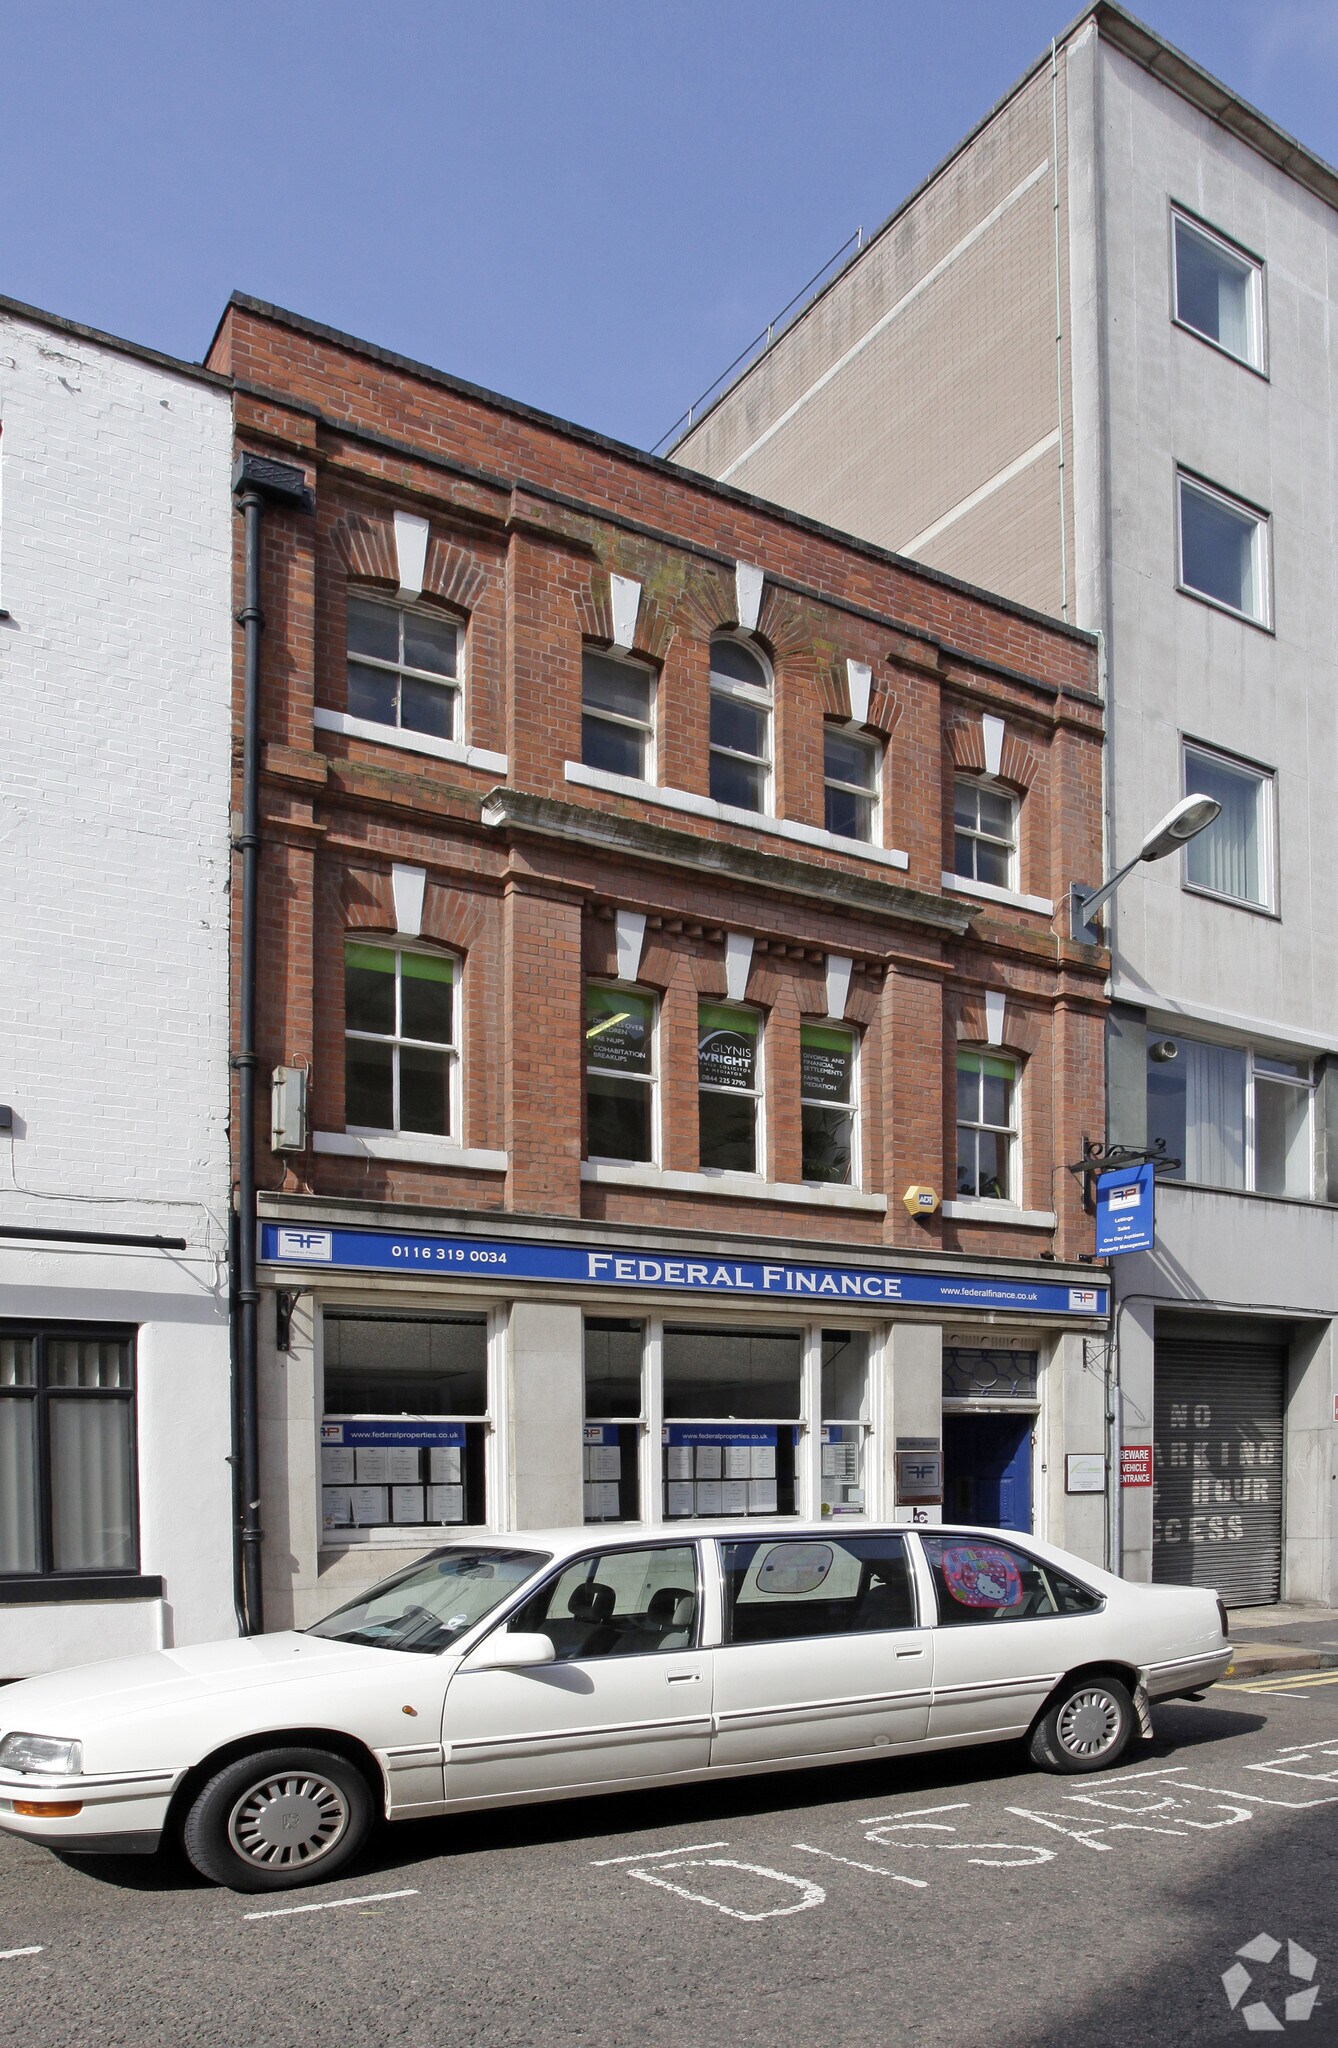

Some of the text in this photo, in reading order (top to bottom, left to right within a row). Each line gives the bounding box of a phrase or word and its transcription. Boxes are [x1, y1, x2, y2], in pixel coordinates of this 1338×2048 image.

[625, 1024, 644, 1032] OVER
[593, 1045, 646, 1058] COHABITATION
[710, 1042, 752, 1058] GLYNIS
[593, 1052, 628, 1062] BREAKUPS
[698, 1052, 752, 1068] WRIGHT
[803, 1053, 830, 1062] DIVORCE
[719, 1064, 752, 1073] SOLICITOR
[803, 1059, 835, 1069] FINANCIAL
[712, 1068, 742, 1077] MEDIATOR
[803, 1066, 843, 1076] SETTLEMENTS
[732, 1078, 747, 1087] 2790
[803, 1081, 837, 1091] MEDIATION
[919, 1196, 933, 1204] ADT
[1123, 1232, 1145, 1240] Auctions
[1119, 1240, 1150, 1250] Management
[391, 1246, 508, 1264] 0116 319 0034
[587, 1252, 902, 1298] FEDERAL FINANCE
[940, 1287, 1038, 1301] www.federalfinance.co.uk
[1171, 1404, 1211, 1428] NO
[350, 1431, 458, 1440] www.federalproperties.co.uk
[682, 1432, 768, 1440] www.federalproperties.co.uk
[1120, 1450, 1149, 1460] BEWARE
[1122, 1463, 1147, 1472] VEHICLE
[1120, 1474, 1150, 1483] ENTRANCE
[1192, 1478, 1269, 1504] HOUR
